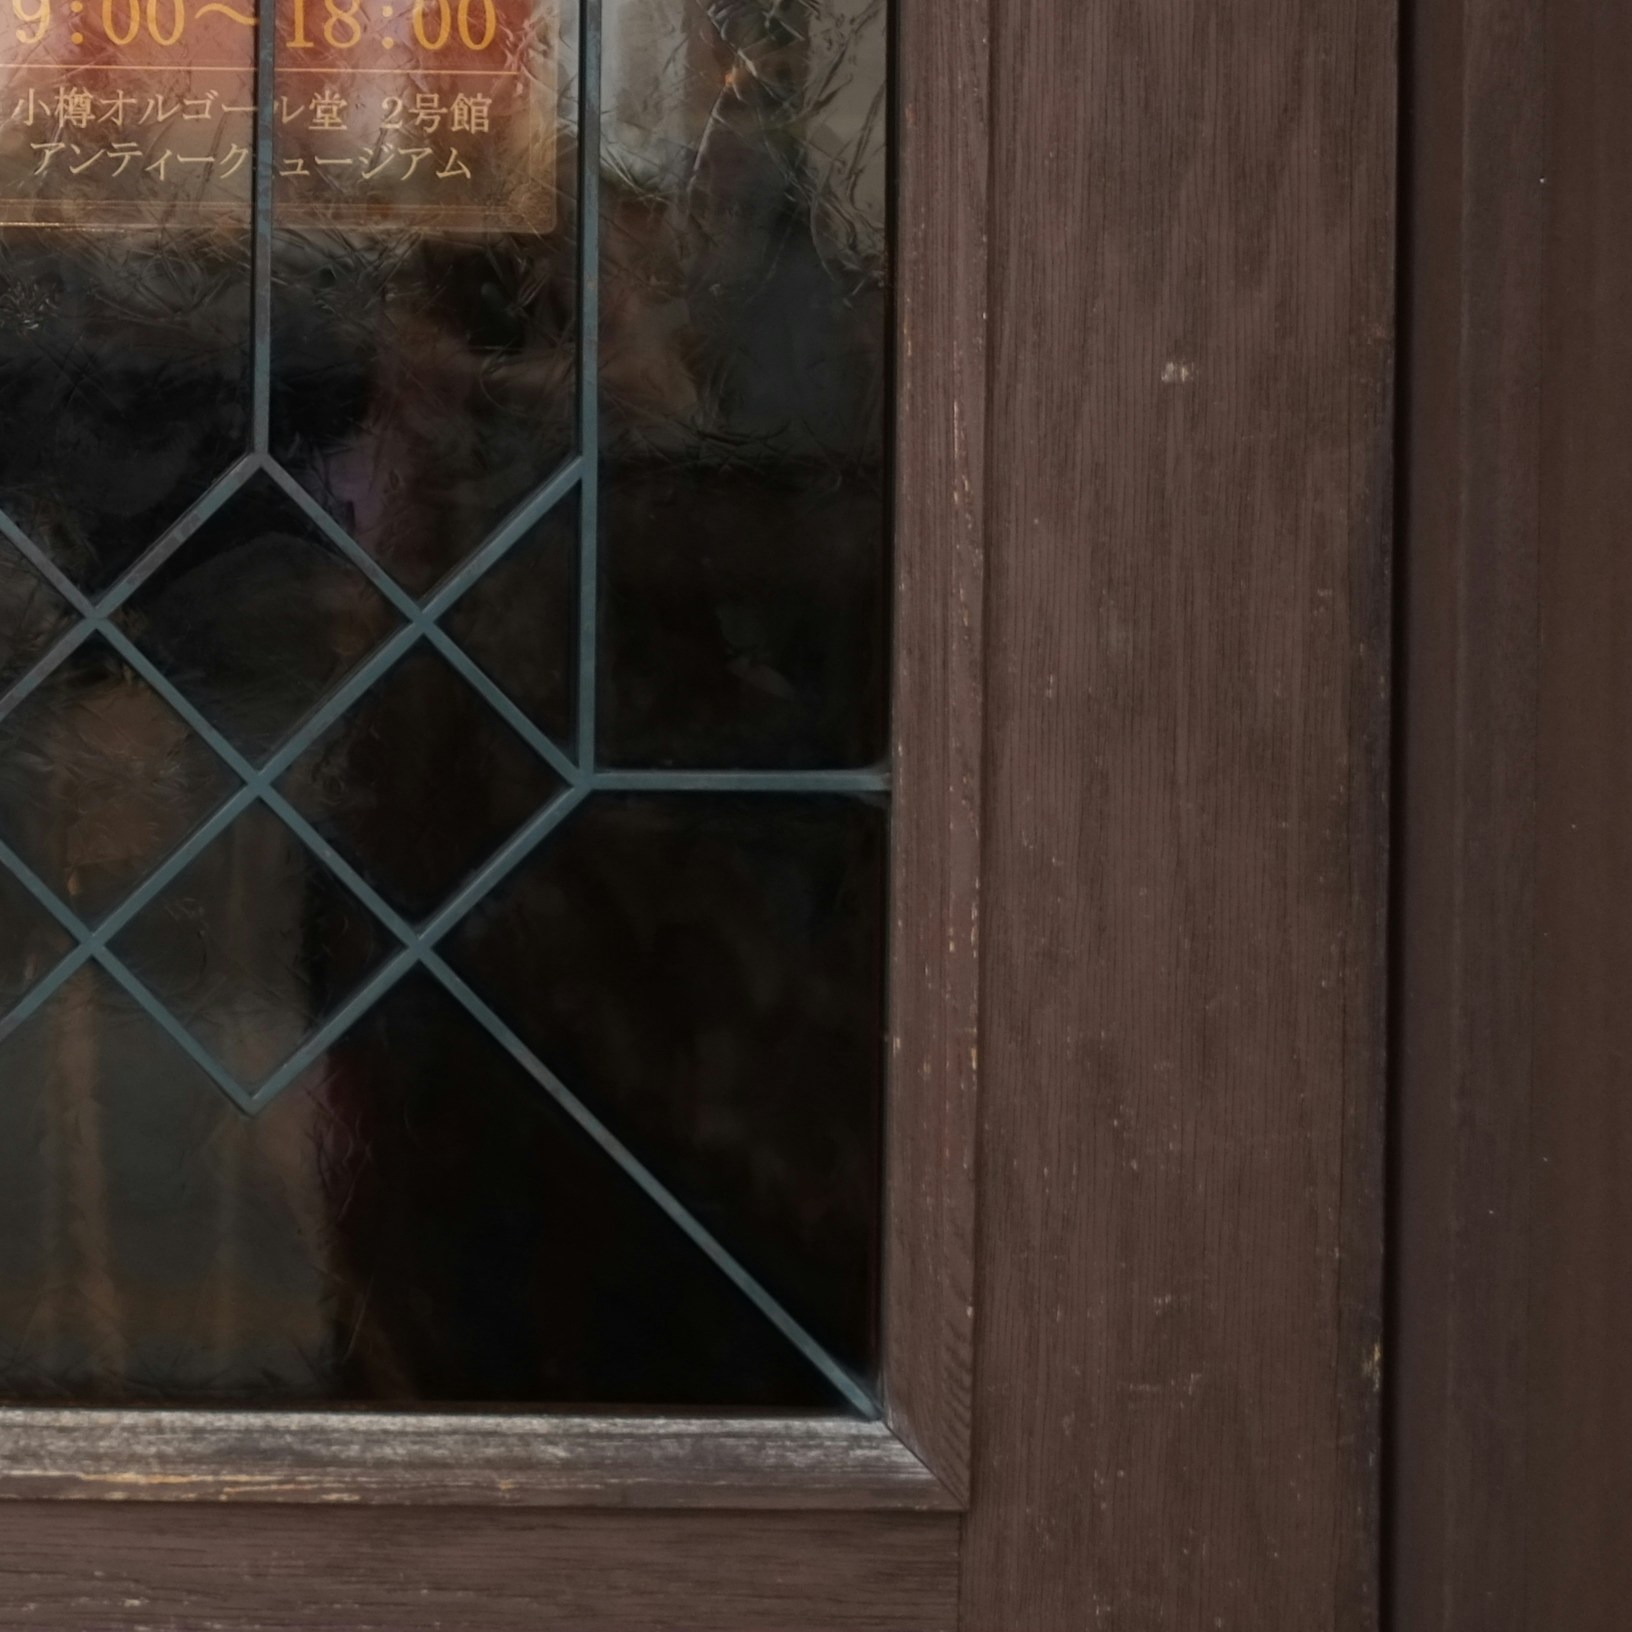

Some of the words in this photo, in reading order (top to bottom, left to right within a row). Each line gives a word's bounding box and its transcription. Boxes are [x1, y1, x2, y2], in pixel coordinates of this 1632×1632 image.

[13, 87, 348, 132] 小樽オルゴール堂
[380, 91, 493, 135] 2号館
[29, 141, 473, 182] アンティークュージアム
